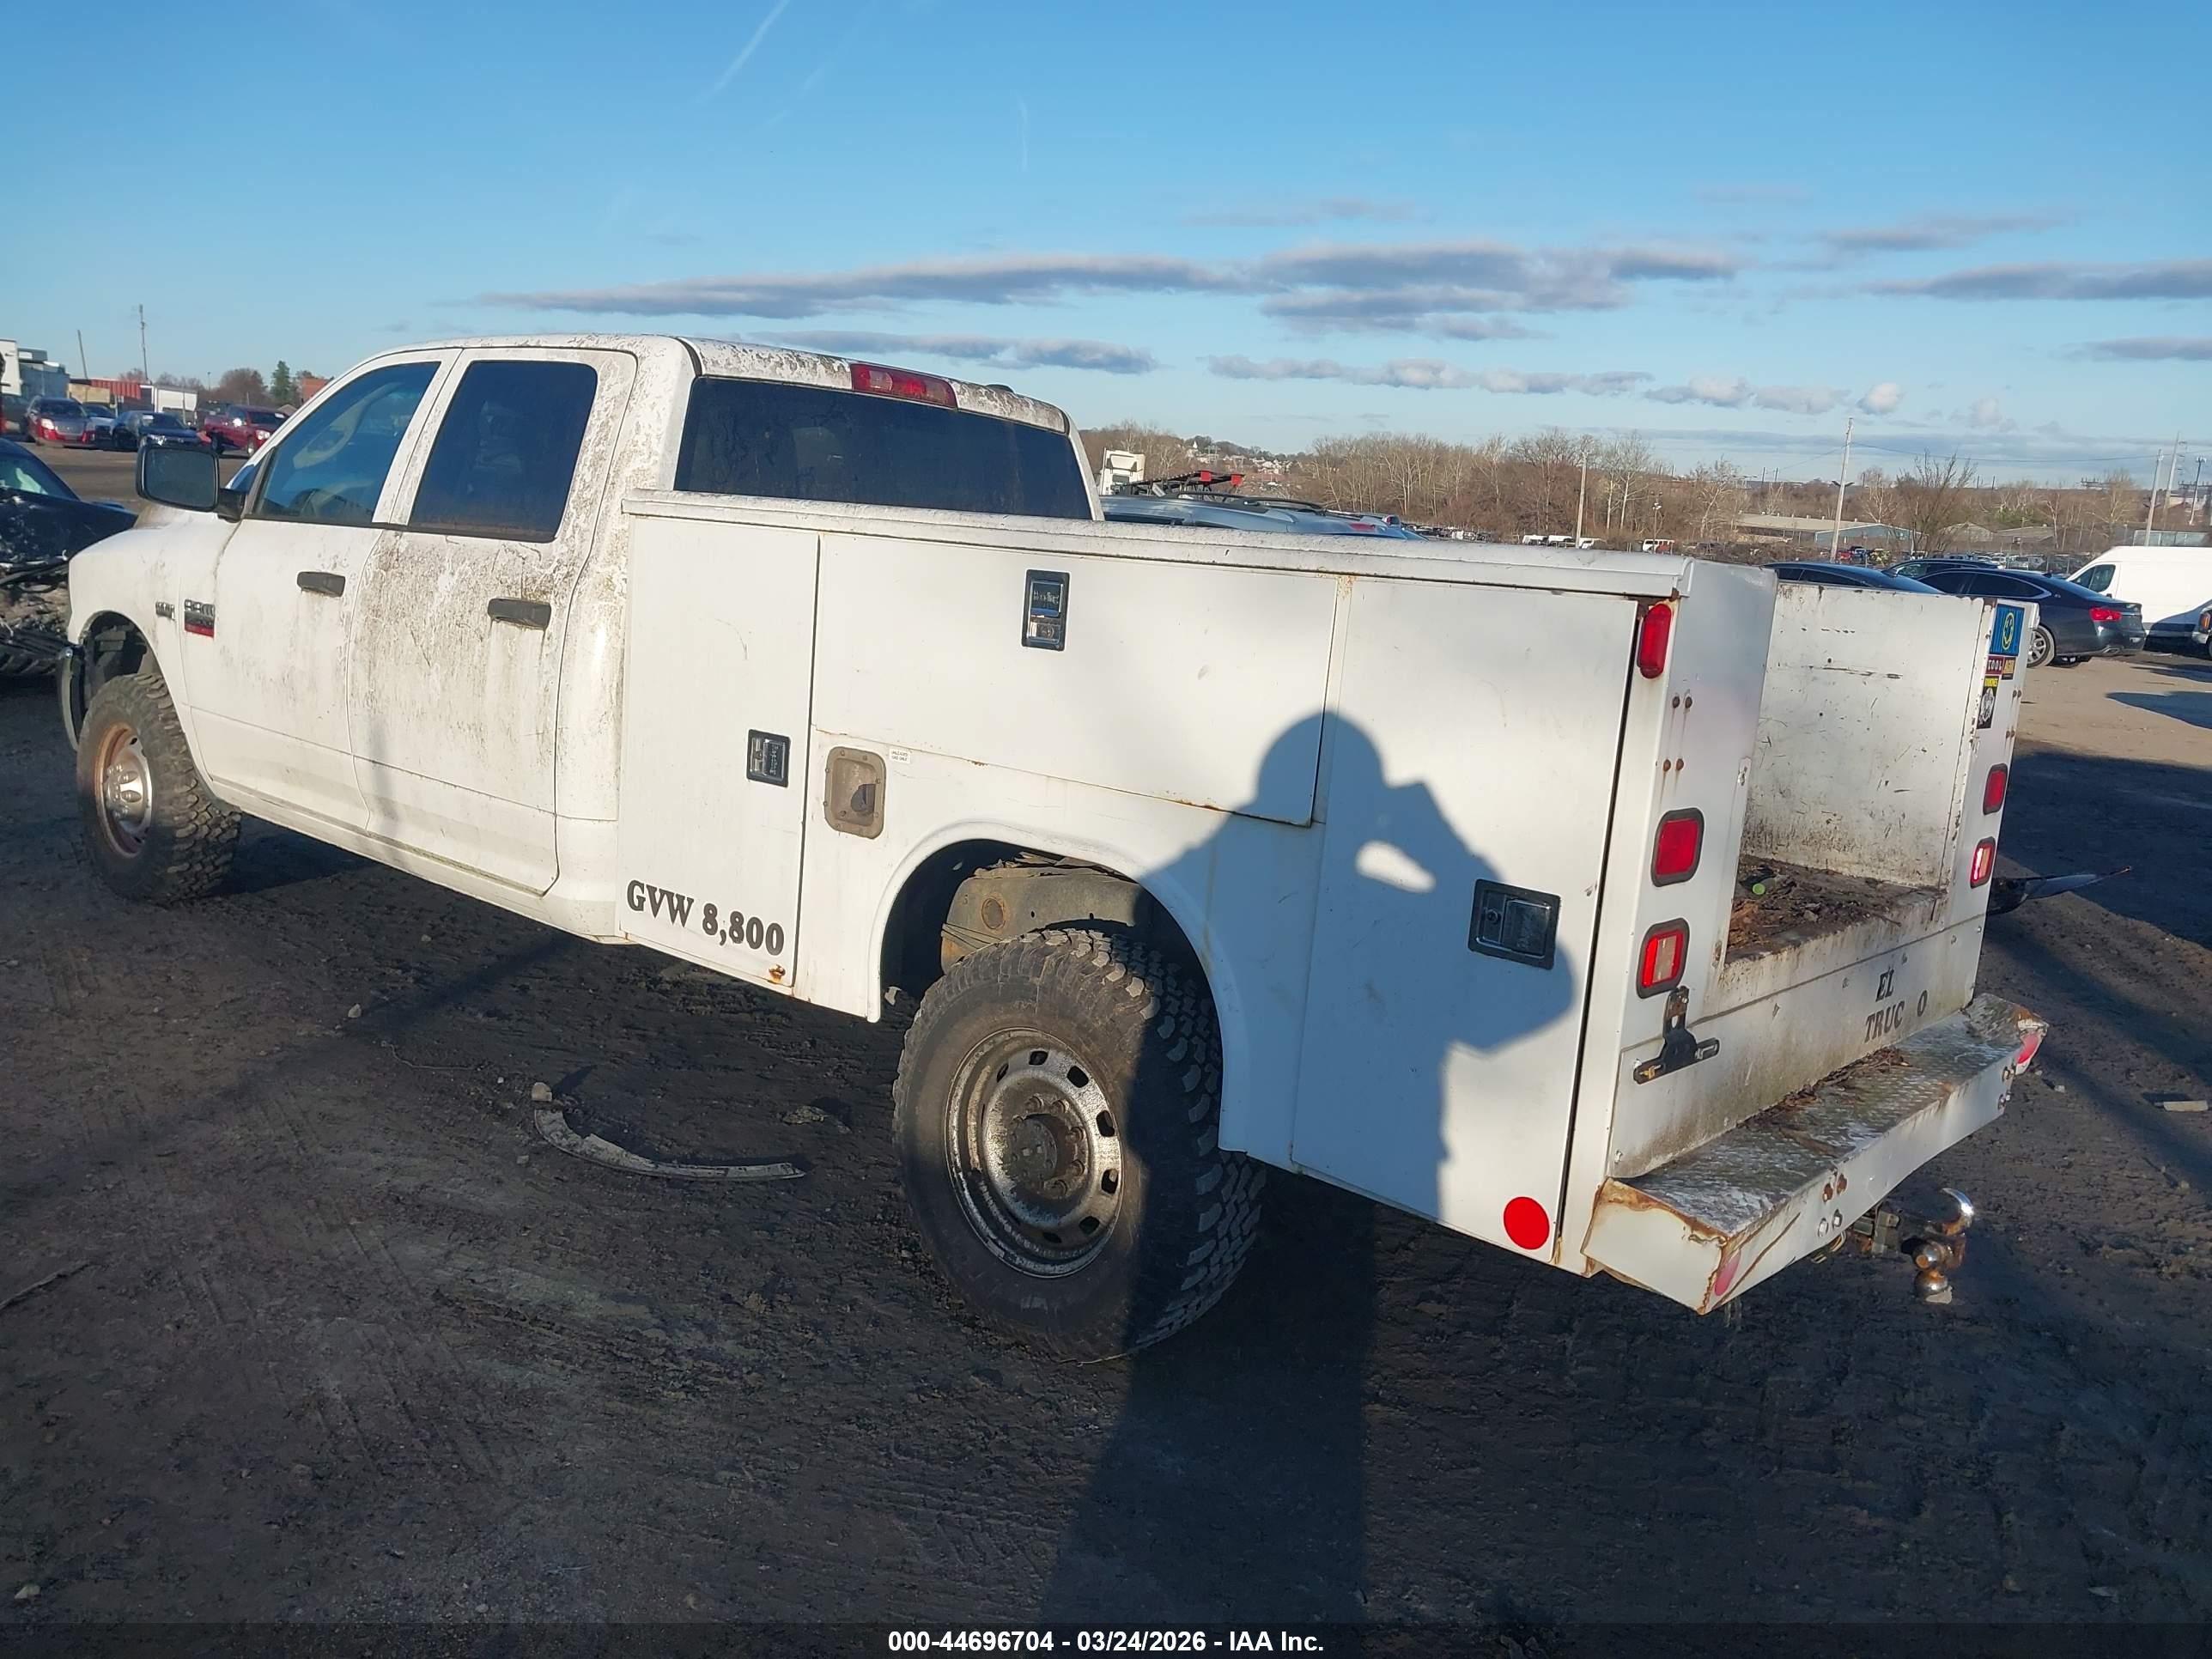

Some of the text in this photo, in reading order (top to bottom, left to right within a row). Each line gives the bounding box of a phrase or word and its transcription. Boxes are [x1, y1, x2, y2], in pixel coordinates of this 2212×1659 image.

[1987, 659, 2002, 671] TOOL
[626, 879, 785, 956] GVW 8,800
[1875, 969, 1894, 1002] EL
